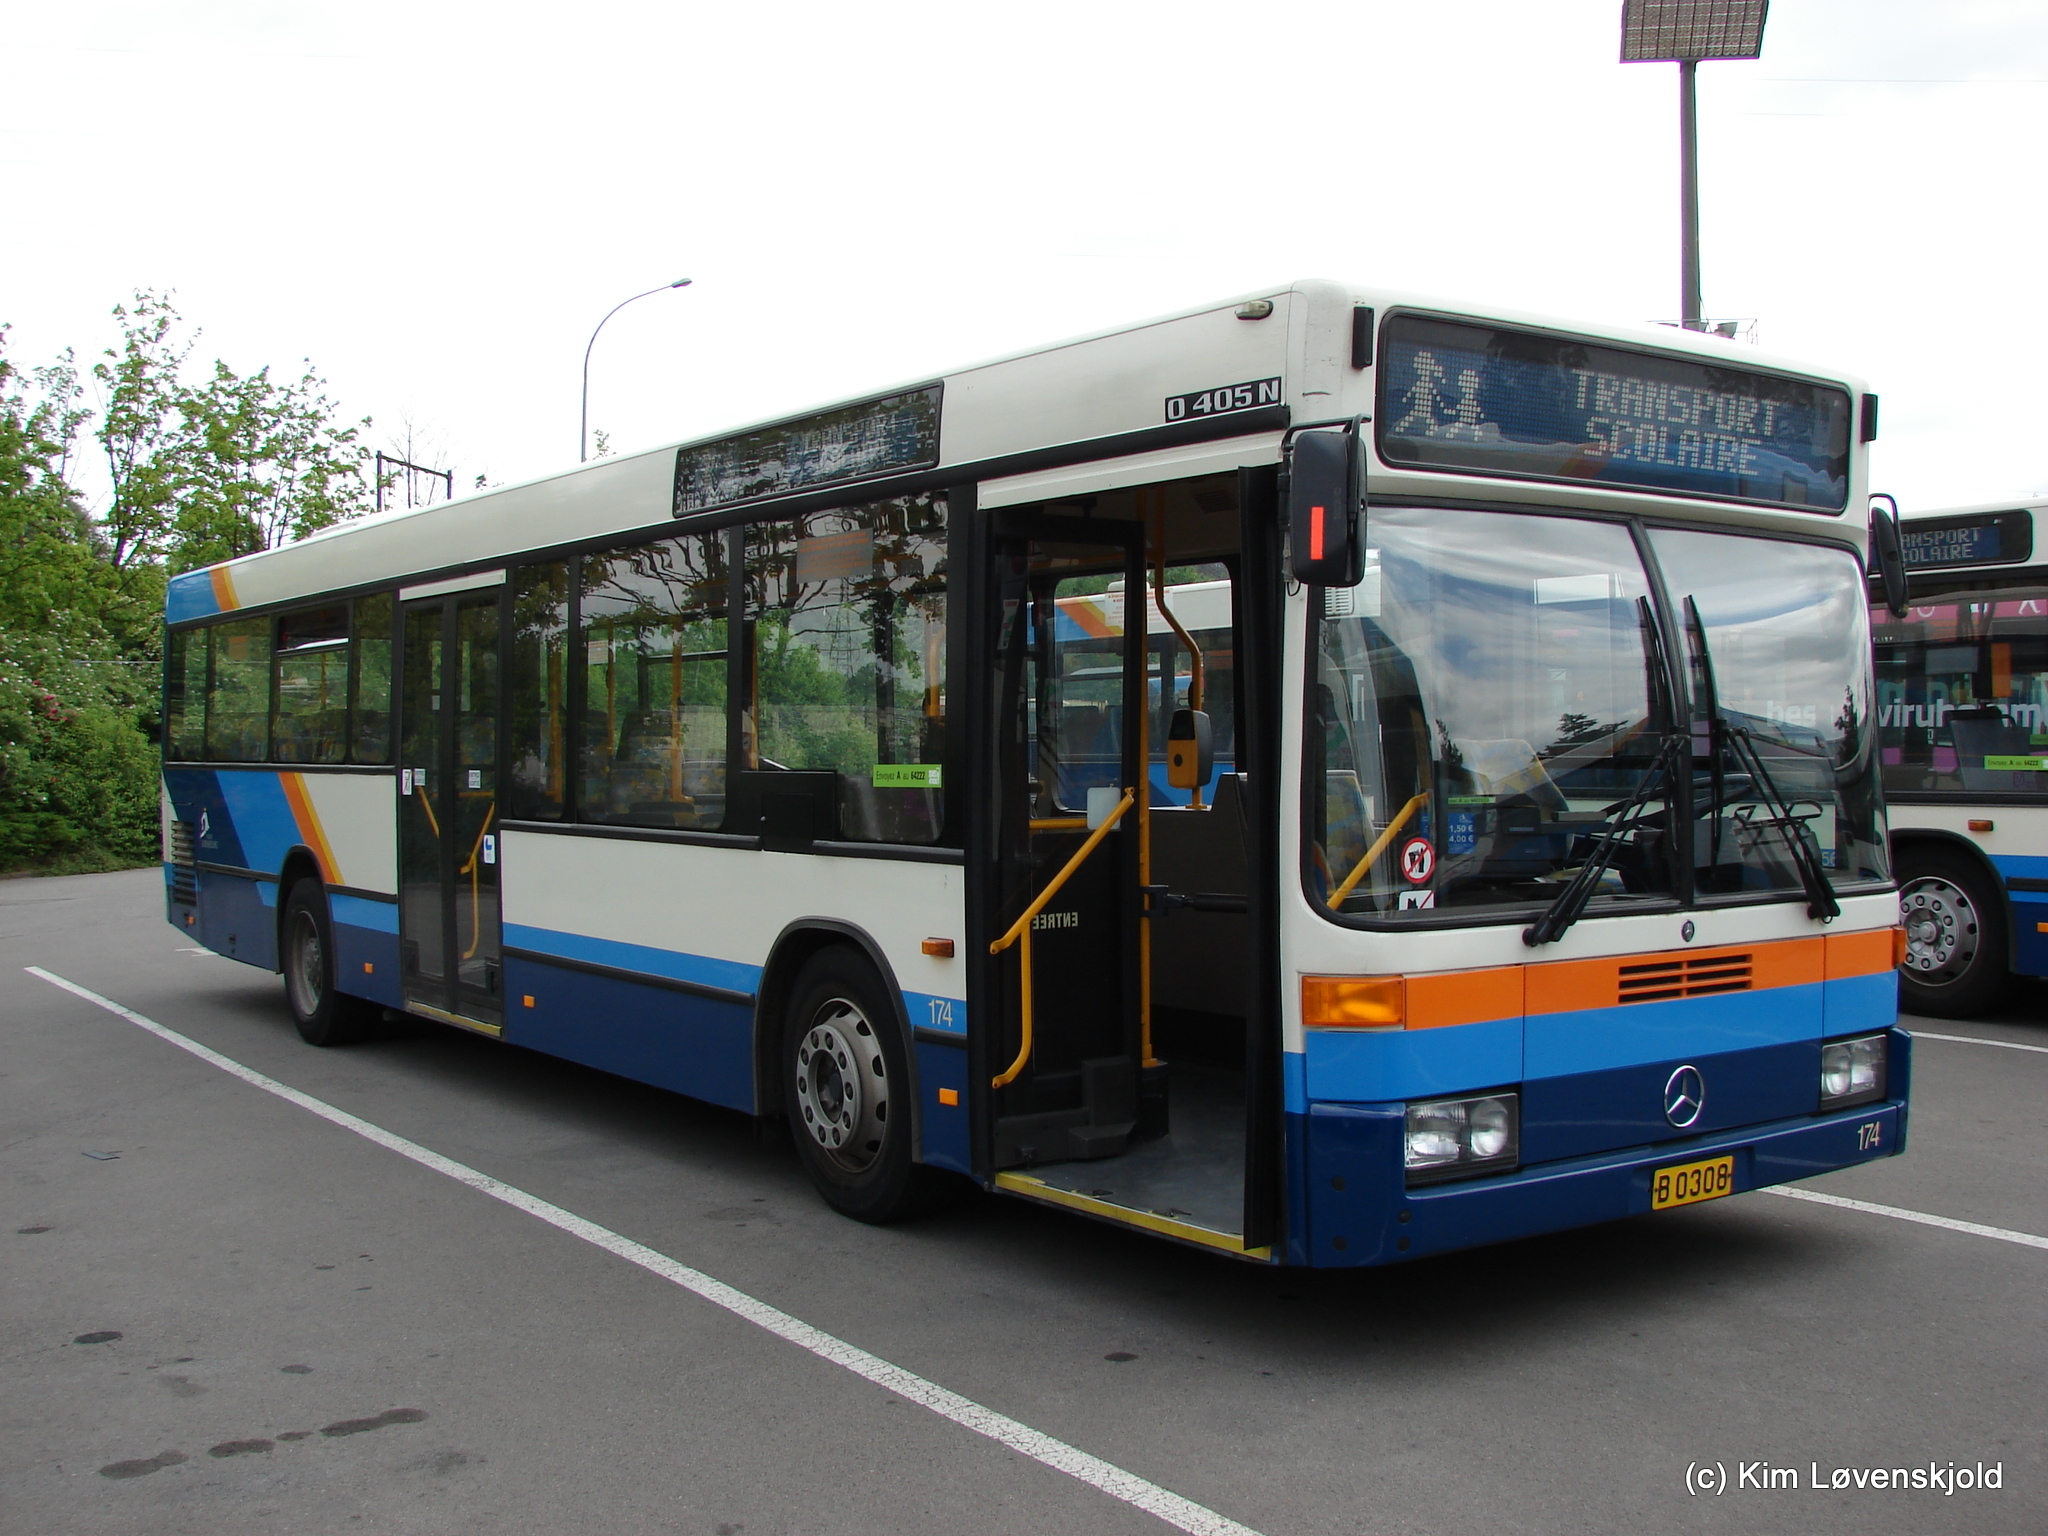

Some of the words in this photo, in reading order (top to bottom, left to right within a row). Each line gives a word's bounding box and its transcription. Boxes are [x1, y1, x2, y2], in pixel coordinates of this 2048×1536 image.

[1192, 385, 1252, 414] 405
[1258, 380, 1279, 403] N
[1571, 368, 1780, 436] TRANSPORT
[1583, 416, 1762, 476] SCOLAIRE
[1901, 526, 1981, 548] ANSPORT
[1902, 543, 1974, 562] COLAIRE
[896, 771, 901, 780] A
[911, 771, 926, 780] 64222
[928, 998, 953, 1028] 174
[1857, 1121, 1880, 1151] 174
[1657, 1174, 1670, 1203] B
[1675, 1163, 1728, 1200] 0308
